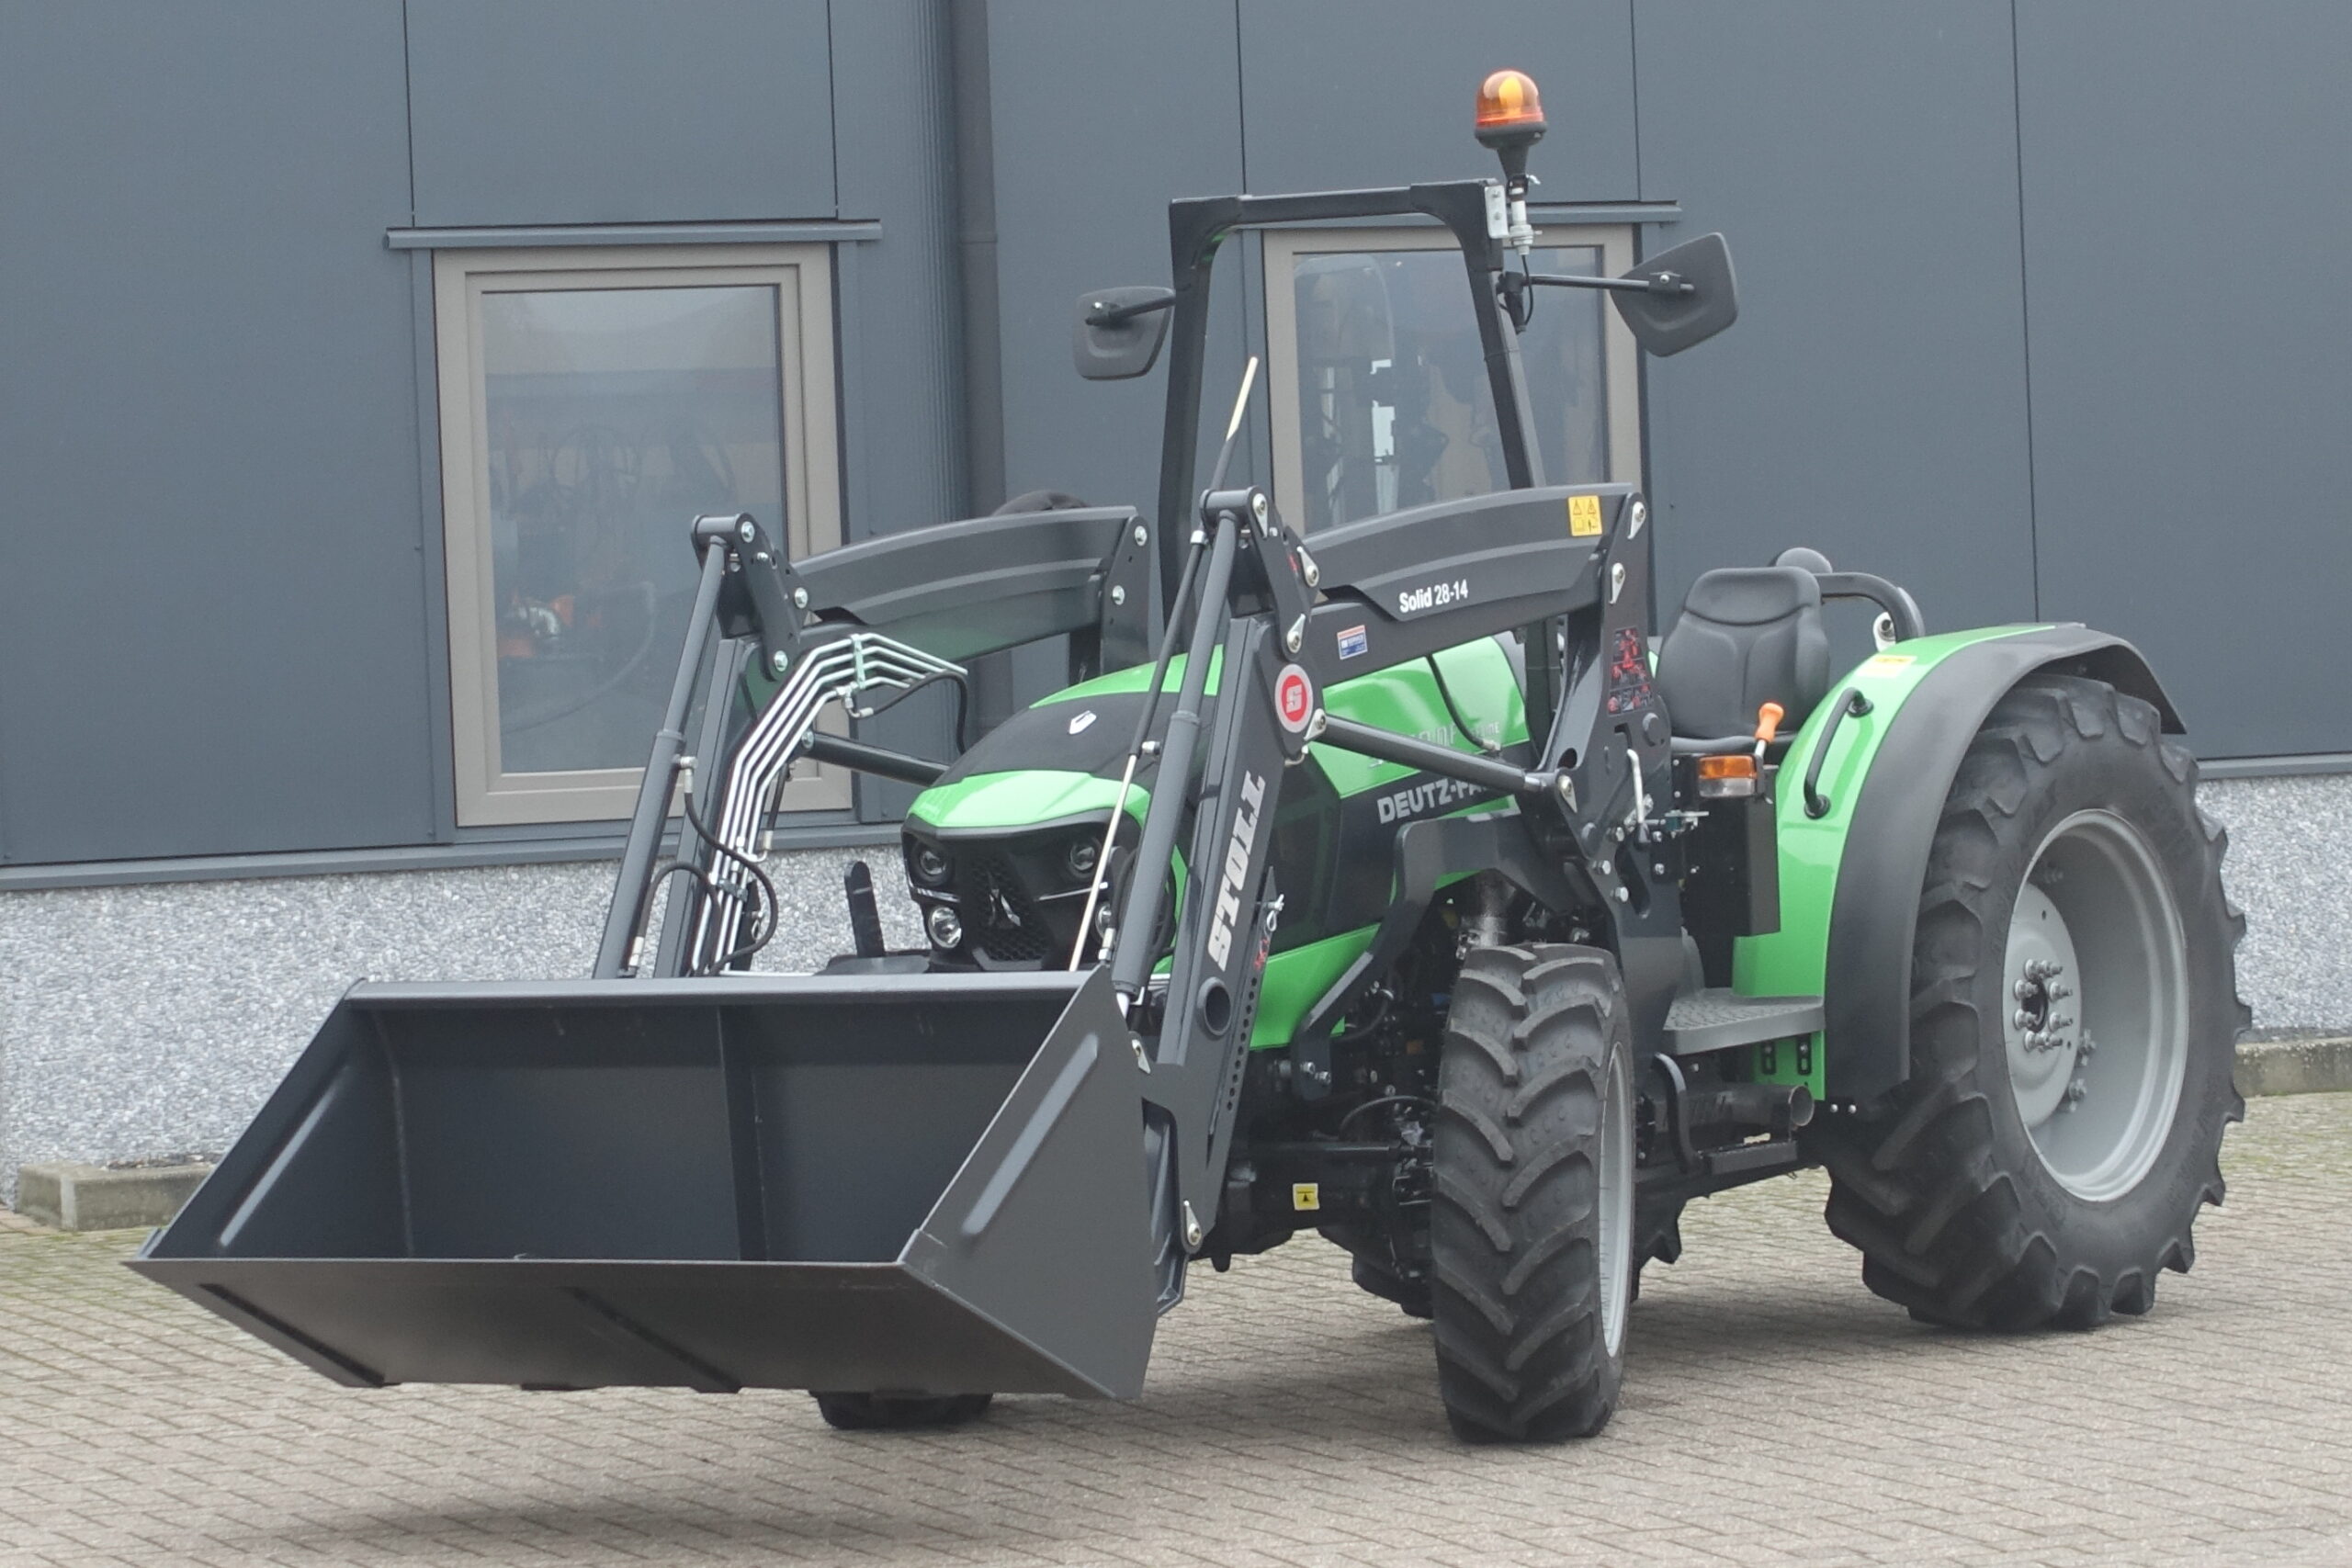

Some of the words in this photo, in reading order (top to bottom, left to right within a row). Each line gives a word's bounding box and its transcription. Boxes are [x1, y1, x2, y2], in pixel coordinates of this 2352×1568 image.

[1398, 586, 1433, 614] Solid
[1433, 578, 1469, 605] 28-14
[1207, 769, 1266, 972] STOLL
